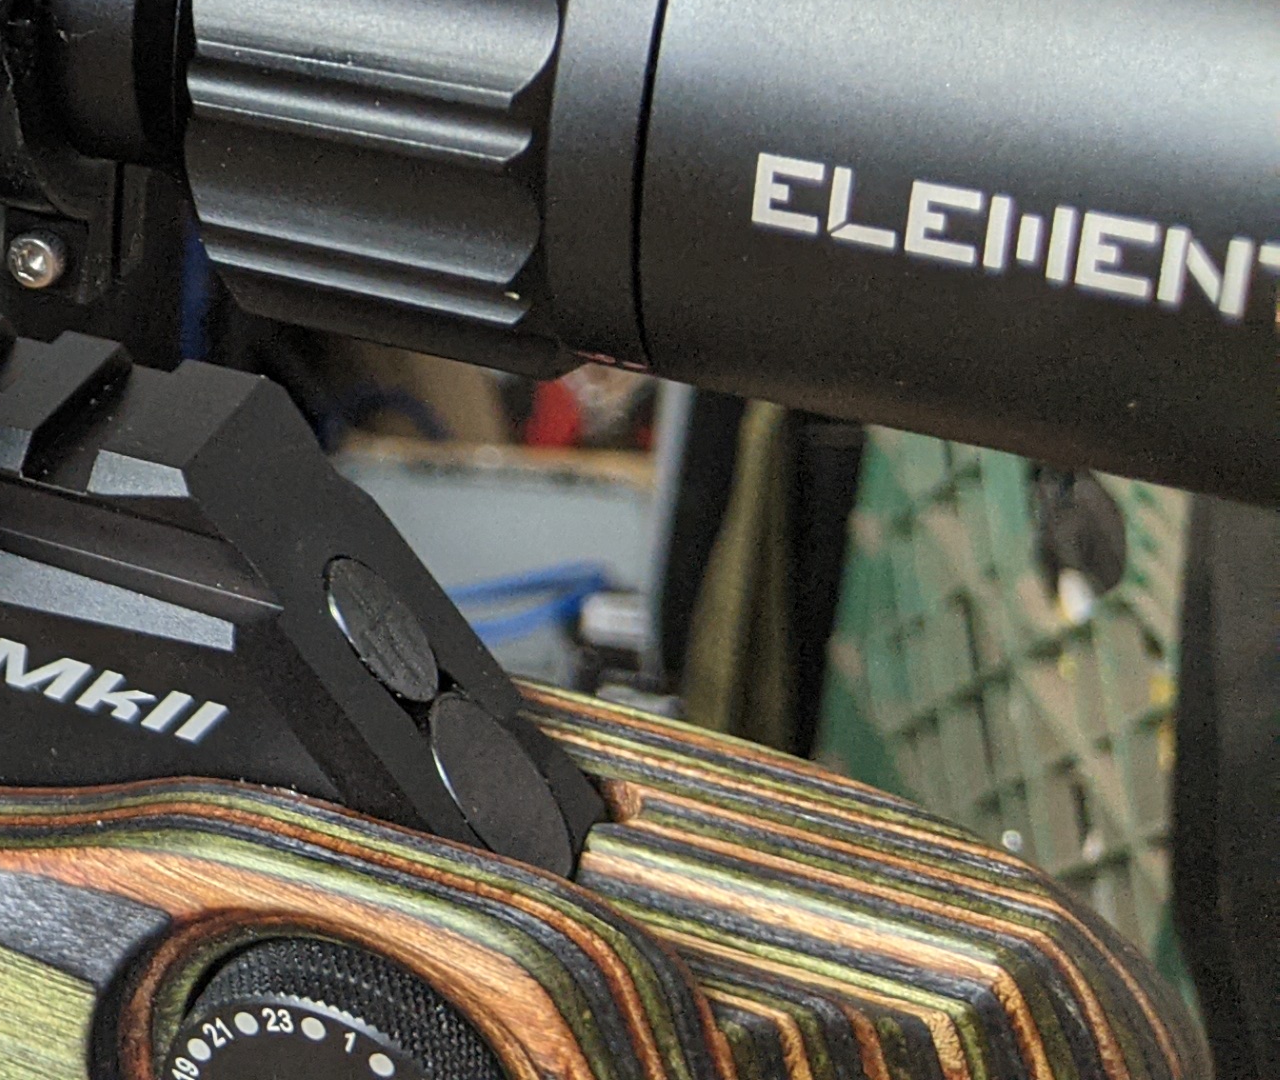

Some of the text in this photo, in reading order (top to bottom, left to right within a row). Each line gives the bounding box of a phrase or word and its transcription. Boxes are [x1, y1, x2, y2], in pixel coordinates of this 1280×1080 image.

[751, 151, 1280, 317] ELEMEN
[202, 1016, 235, 1048] 21
[261, 1007, 295, 1034] 23
[343, 1031, 357, 1054] 1
